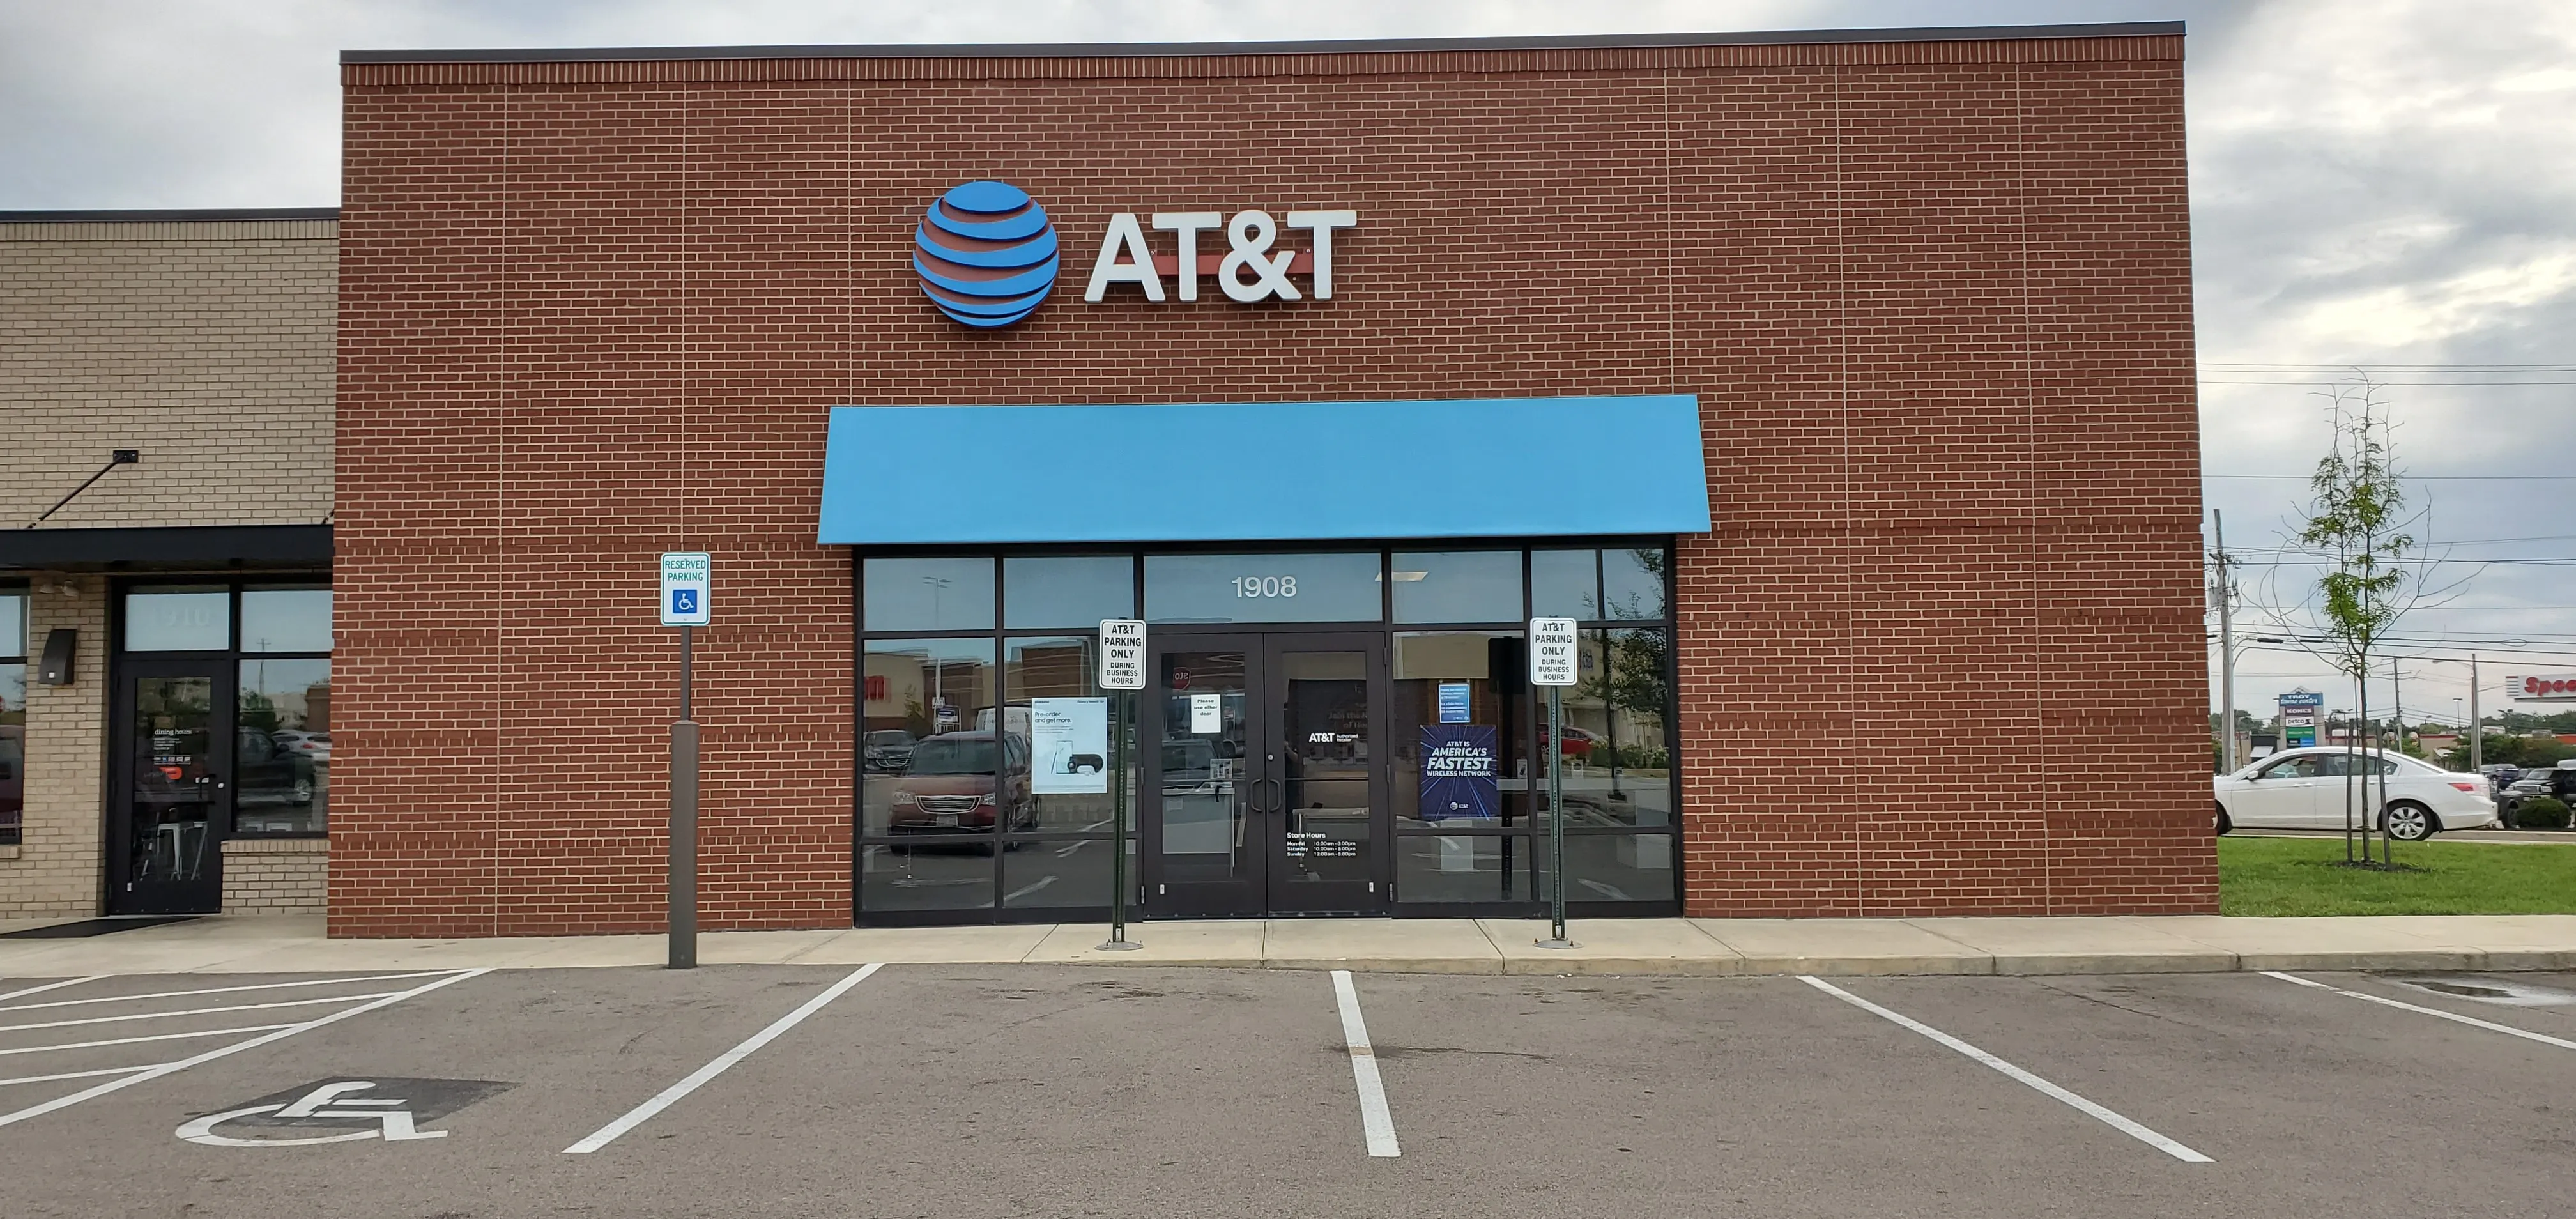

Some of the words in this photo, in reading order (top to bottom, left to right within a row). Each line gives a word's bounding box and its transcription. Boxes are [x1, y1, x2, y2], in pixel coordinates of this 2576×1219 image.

[1084, 210, 1357, 303] AT&T
[665, 560, 706, 569] RESERVED
[668, 572, 703, 581] PARKING
[1231, 576, 1297, 597] 1908
[1112, 625, 1135, 634] AT&T
[1542, 623, 1565, 632] AT&T
[1104, 637, 1142, 647] PARKING
[1535, 634, 1572, 643] PARKING
[1111, 649, 1135, 659] ONLY
[1542, 647, 1565, 656] ONLY
[2524, 677, 2576, 696] Spee
[1308, 732, 1335, 742] AT&T
[1432, 747, 1488, 756] AMERICA'S
[1427, 757, 1492, 770] FASTEST
